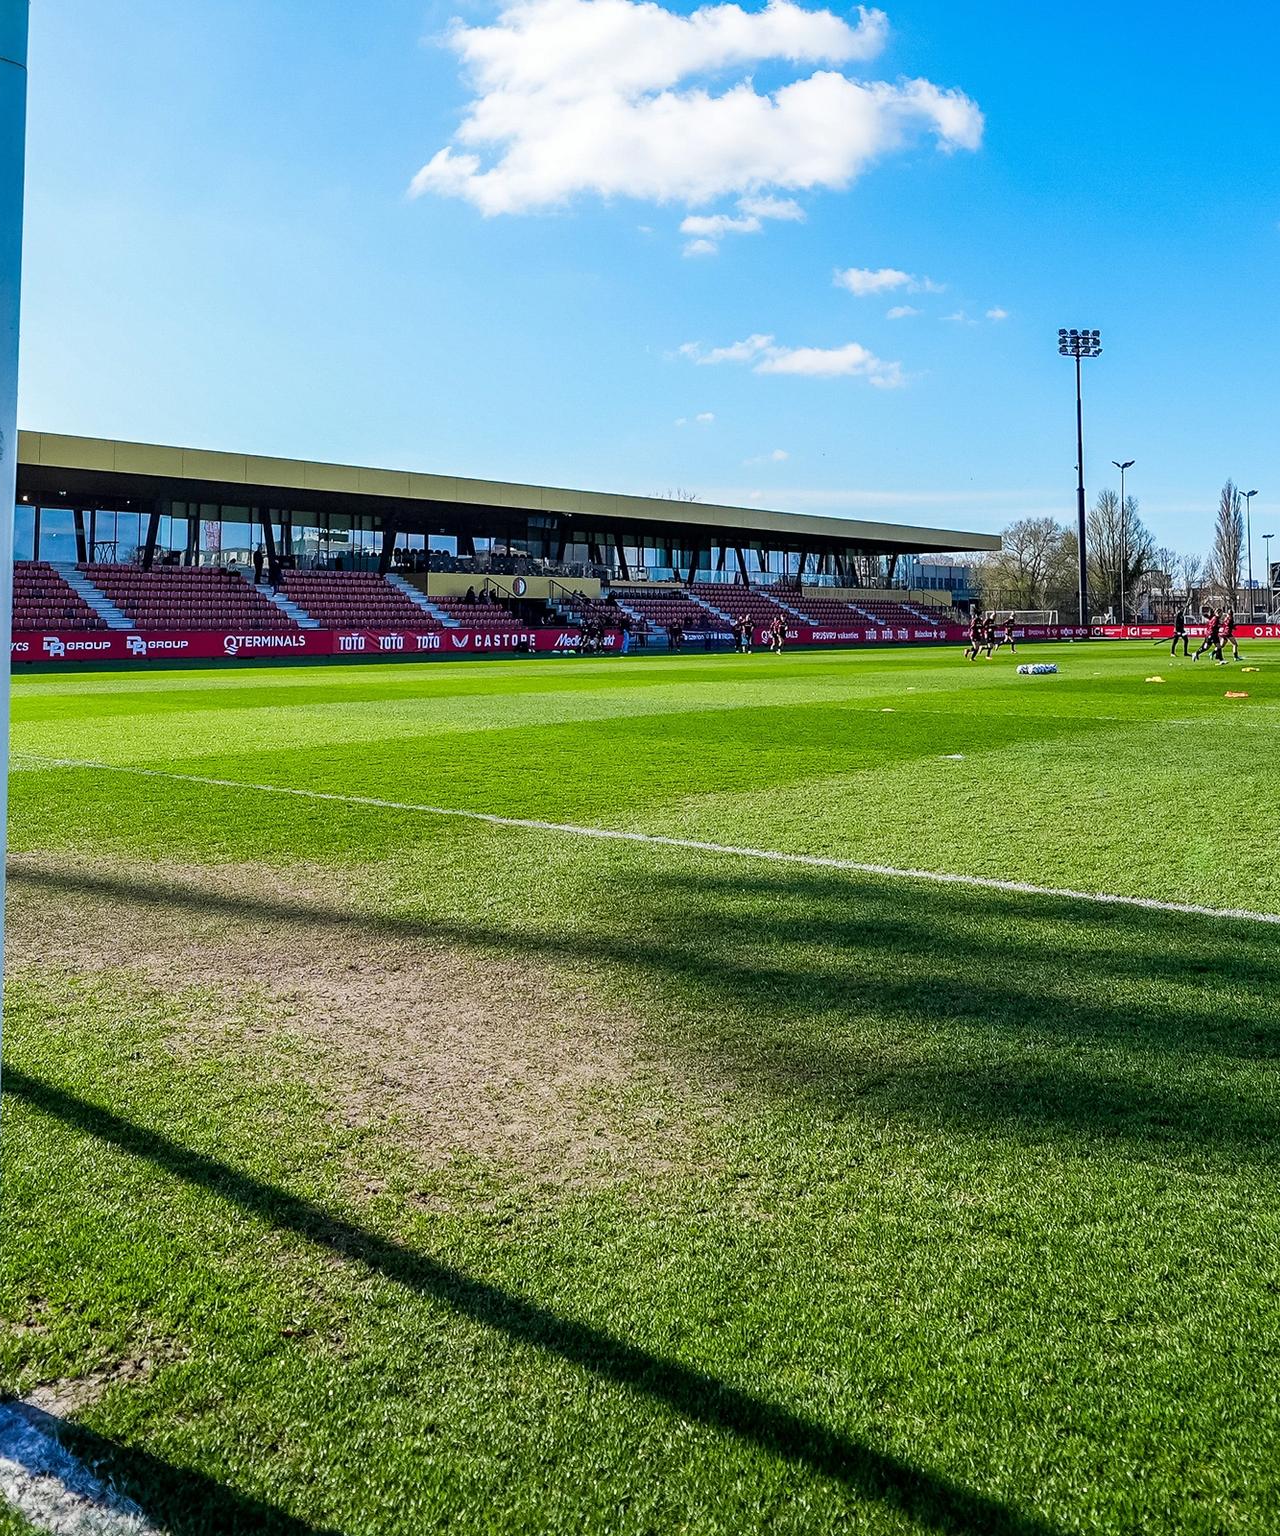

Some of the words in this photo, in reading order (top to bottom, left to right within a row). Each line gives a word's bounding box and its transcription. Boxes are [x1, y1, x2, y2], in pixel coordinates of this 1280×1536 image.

[66, 642, 111, 650] GROUP
[148, 640, 189, 649] GROUP
[339, 634, 365, 650] TOTO
[378, 634, 404, 649] TOTO
[416, 634, 440, 648] TOTO
